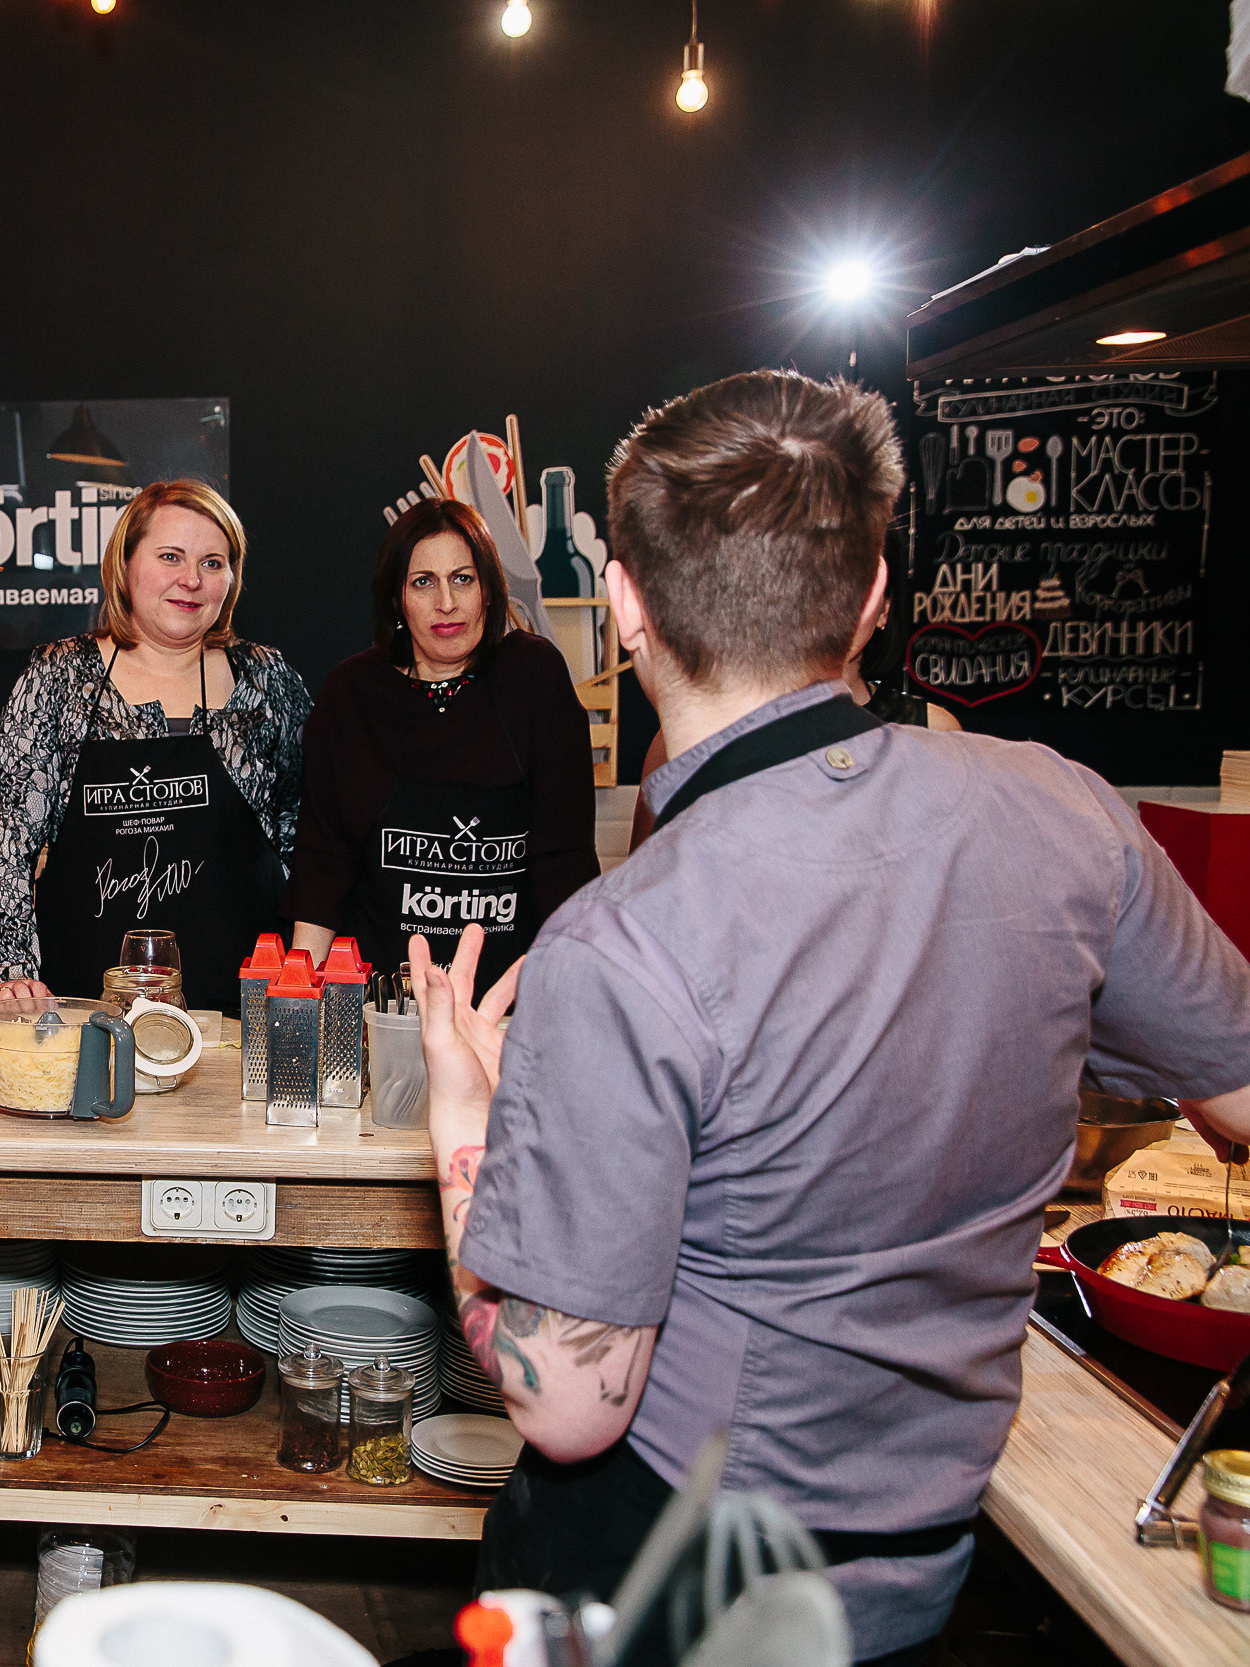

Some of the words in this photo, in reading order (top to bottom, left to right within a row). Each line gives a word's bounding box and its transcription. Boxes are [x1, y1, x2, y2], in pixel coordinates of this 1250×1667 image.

[99, 486, 143, 501] since
[932, 562, 999, 595] ДНИ
[913, 590, 1032, 624] РОЖДЕНИЯ
[915, 649, 1033, 686] СВИДАНИЯ
[1061, 684, 1175, 709] КУРСЫ
[87, 787, 126, 804] ИГРА
[129, 779, 203, 802] СТОЛОВ
[100, 801, 150, 811] КУЛИНАРНАЯ
[153, 798, 184, 808] СТУДИЯ
[115, 827, 143, 836] РОГОЗА
[143, 823, 175, 833] МИХАИЛ
[122, 816, 165, 827] ШЕФ-ПОВАР
[387, 833, 444, 860] ИГРА
[449, 840, 526, 862] СТОЛО
[407, 858, 474, 871] КУЛИНАРНАЯ
[478, 862, 514, 871] СТУДИЯ
[401, 883, 518, 923] körting
[400, 923, 466, 936] встраиваем
[483, 922, 515, 935] ехника
